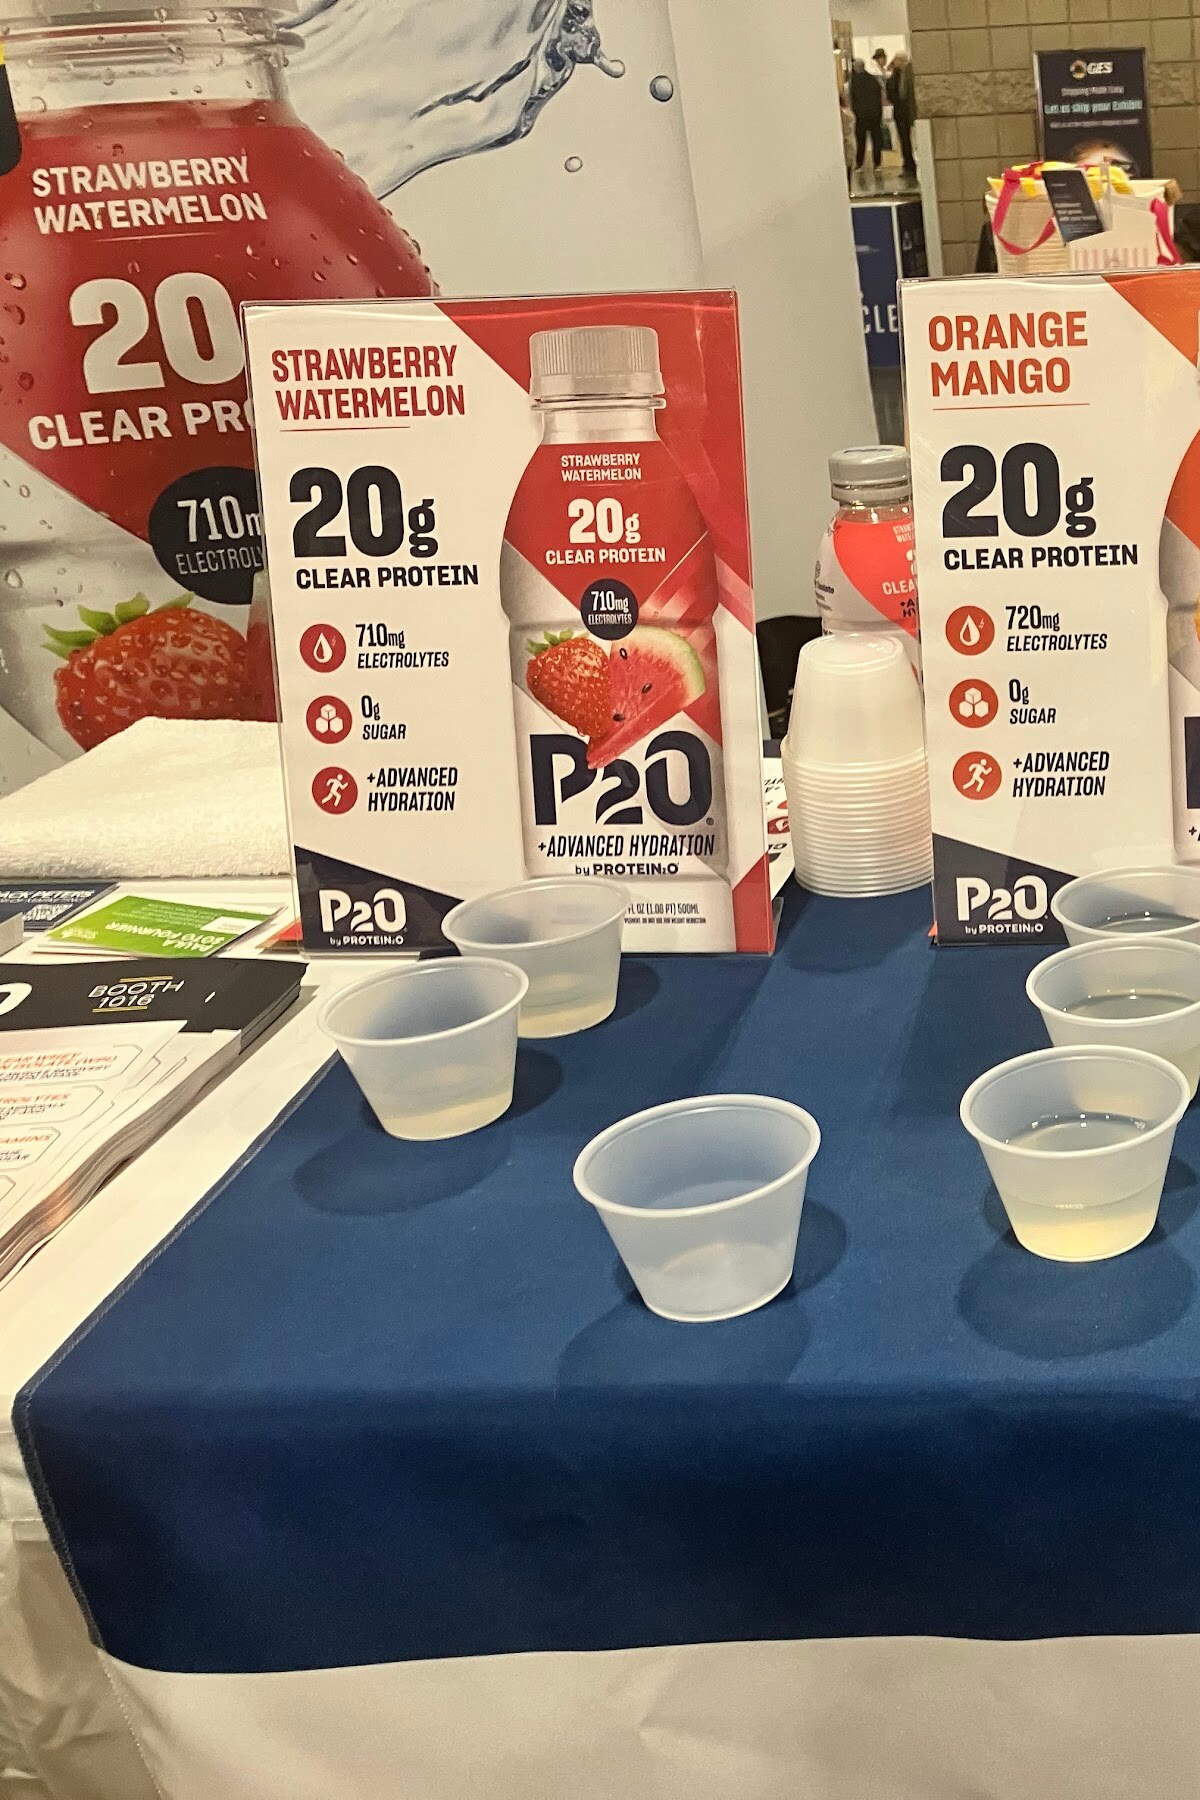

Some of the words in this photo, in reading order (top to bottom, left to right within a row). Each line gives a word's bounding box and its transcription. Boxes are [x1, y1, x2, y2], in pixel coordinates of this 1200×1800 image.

[1087, 61, 1113, 75] GES
[32, 156, 250, 198] STRAWBERRY
[34, 192, 268, 235] WATERMELON
[69, 272, 247, 394] 20
[928, 311, 1088, 352] ORANGE
[271, 345, 457, 383] STRAWBERRY
[930, 357, 1071, 397] MANGO
[275, 385, 465, 420] WATERMELON
[28, 406, 172, 450] CLEAR
[181, 399, 255, 436] PR
[561, 453, 641, 467] STRAWBERRY
[561, 468, 642, 482] WATERMELON
[940, 442, 1097, 538] 20g
[289, 465, 439, 558] 20g
[567, 497, 641, 544] 20g
[545, 549, 595, 565] CLEAR
[599, 547, 666, 563] PROTEIN
[944, 547, 1024, 570] CLEAR
[1031, 544, 1138, 568] PROTEIN
[296, 567, 371, 589] CLEAR
[378, 564, 479, 588] PROTEIN
[591, 590, 629, 613] 710mg
[588, 613, 632, 625] ELECTROLYTES
[1005, 605, 1060, 632] 720mg
[355, 623, 405, 649] 710mg
[1006, 633, 1108, 652] ELECTROLYTES
[357, 651, 450, 669] ELECTROLYTES
[1009, 678, 1029, 704] 0g
[361, 695, 380, 721] 0g
[1009, 708, 1057, 724] SUGAR
[362, 724, 406, 740] SUGAR
[1013, 751, 1110, 773] +ADVANCED
[366, 767, 458, 788] +ADVANCED
[1012, 776, 1106, 798] HYDRATION
[368, 791, 456, 812] HYDRATION
[538, 835, 624, 857] +ADVANCED
[630, 834, 715, 856] HYDRATION
[575, 865, 590, 876] by
[677, 902, 699, 914] 500ML
[965, 925, 977, 935] by
[329, 936, 342, 947] by
[88, 980, 185, 998] BOOTH
[98, 994, 155, 1009] 1016
